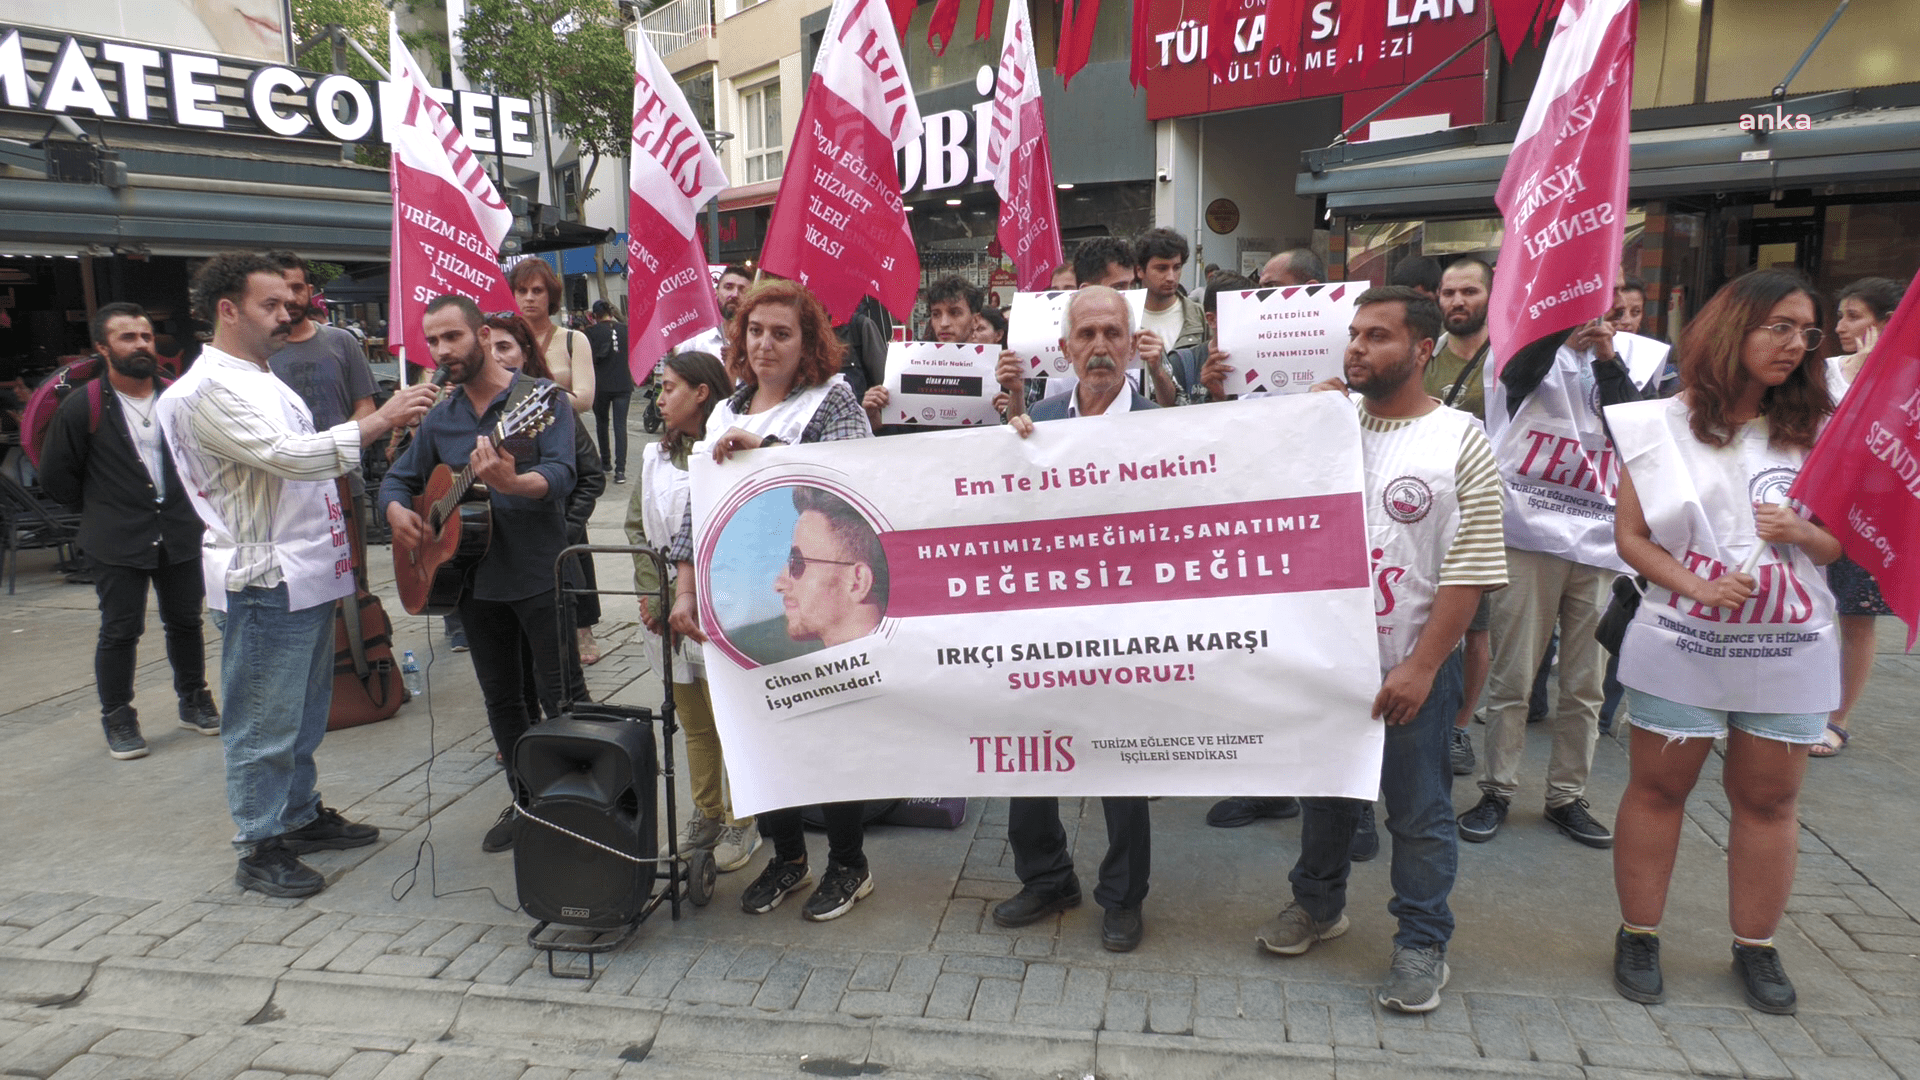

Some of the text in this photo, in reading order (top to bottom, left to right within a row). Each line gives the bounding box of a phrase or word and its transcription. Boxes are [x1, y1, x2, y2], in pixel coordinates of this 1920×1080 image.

[252, 66, 534, 156] COEE
[814, 168, 872, 214] HİZMET
[839, 151, 903, 213] EĞLENCE
[809, 195, 851, 231] İLERİ
[435, 250, 495, 292] HİZMET
[1260, 310, 1320, 321] KATLEDİLEN
[1258, 329, 1325, 340] MÜZİSYENLER
[1257, 348, 1329, 358] İSYANIMIZDIR!
[955, 453, 1217, 496] Em Te Ji Bîr Nakin!
[1510, 482, 1546, 497] TURİZM
[1546, 487, 1590, 507] EĞLENCE
[1527, 496, 1566, 514] İŞÇİLERİ
[948, 549, 1291, 597] DEĞERSİZ DEĞİL!
[1657, 615, 1820, 644] TURİZM EĞLENCE VE HİZMET
[937, 629, 1269, 668] IRKÇI SALDIRILARA KARŞI
[1676, 636, 1793, 658] İŞÇİLERİ SENDİKASI
[765, 652, 870, 690] Cihan AYMAZ
[1008, 663, 1196, 690] SUSMUYORUZ!
[969, 730, 1076, 773] TEHİS
[1091, 733, 1264, 749] TURİZM EĞLENCE VE HİZMET
[1120, 748, 1238, 764] İŞÇİLERİ SENDİKASI
